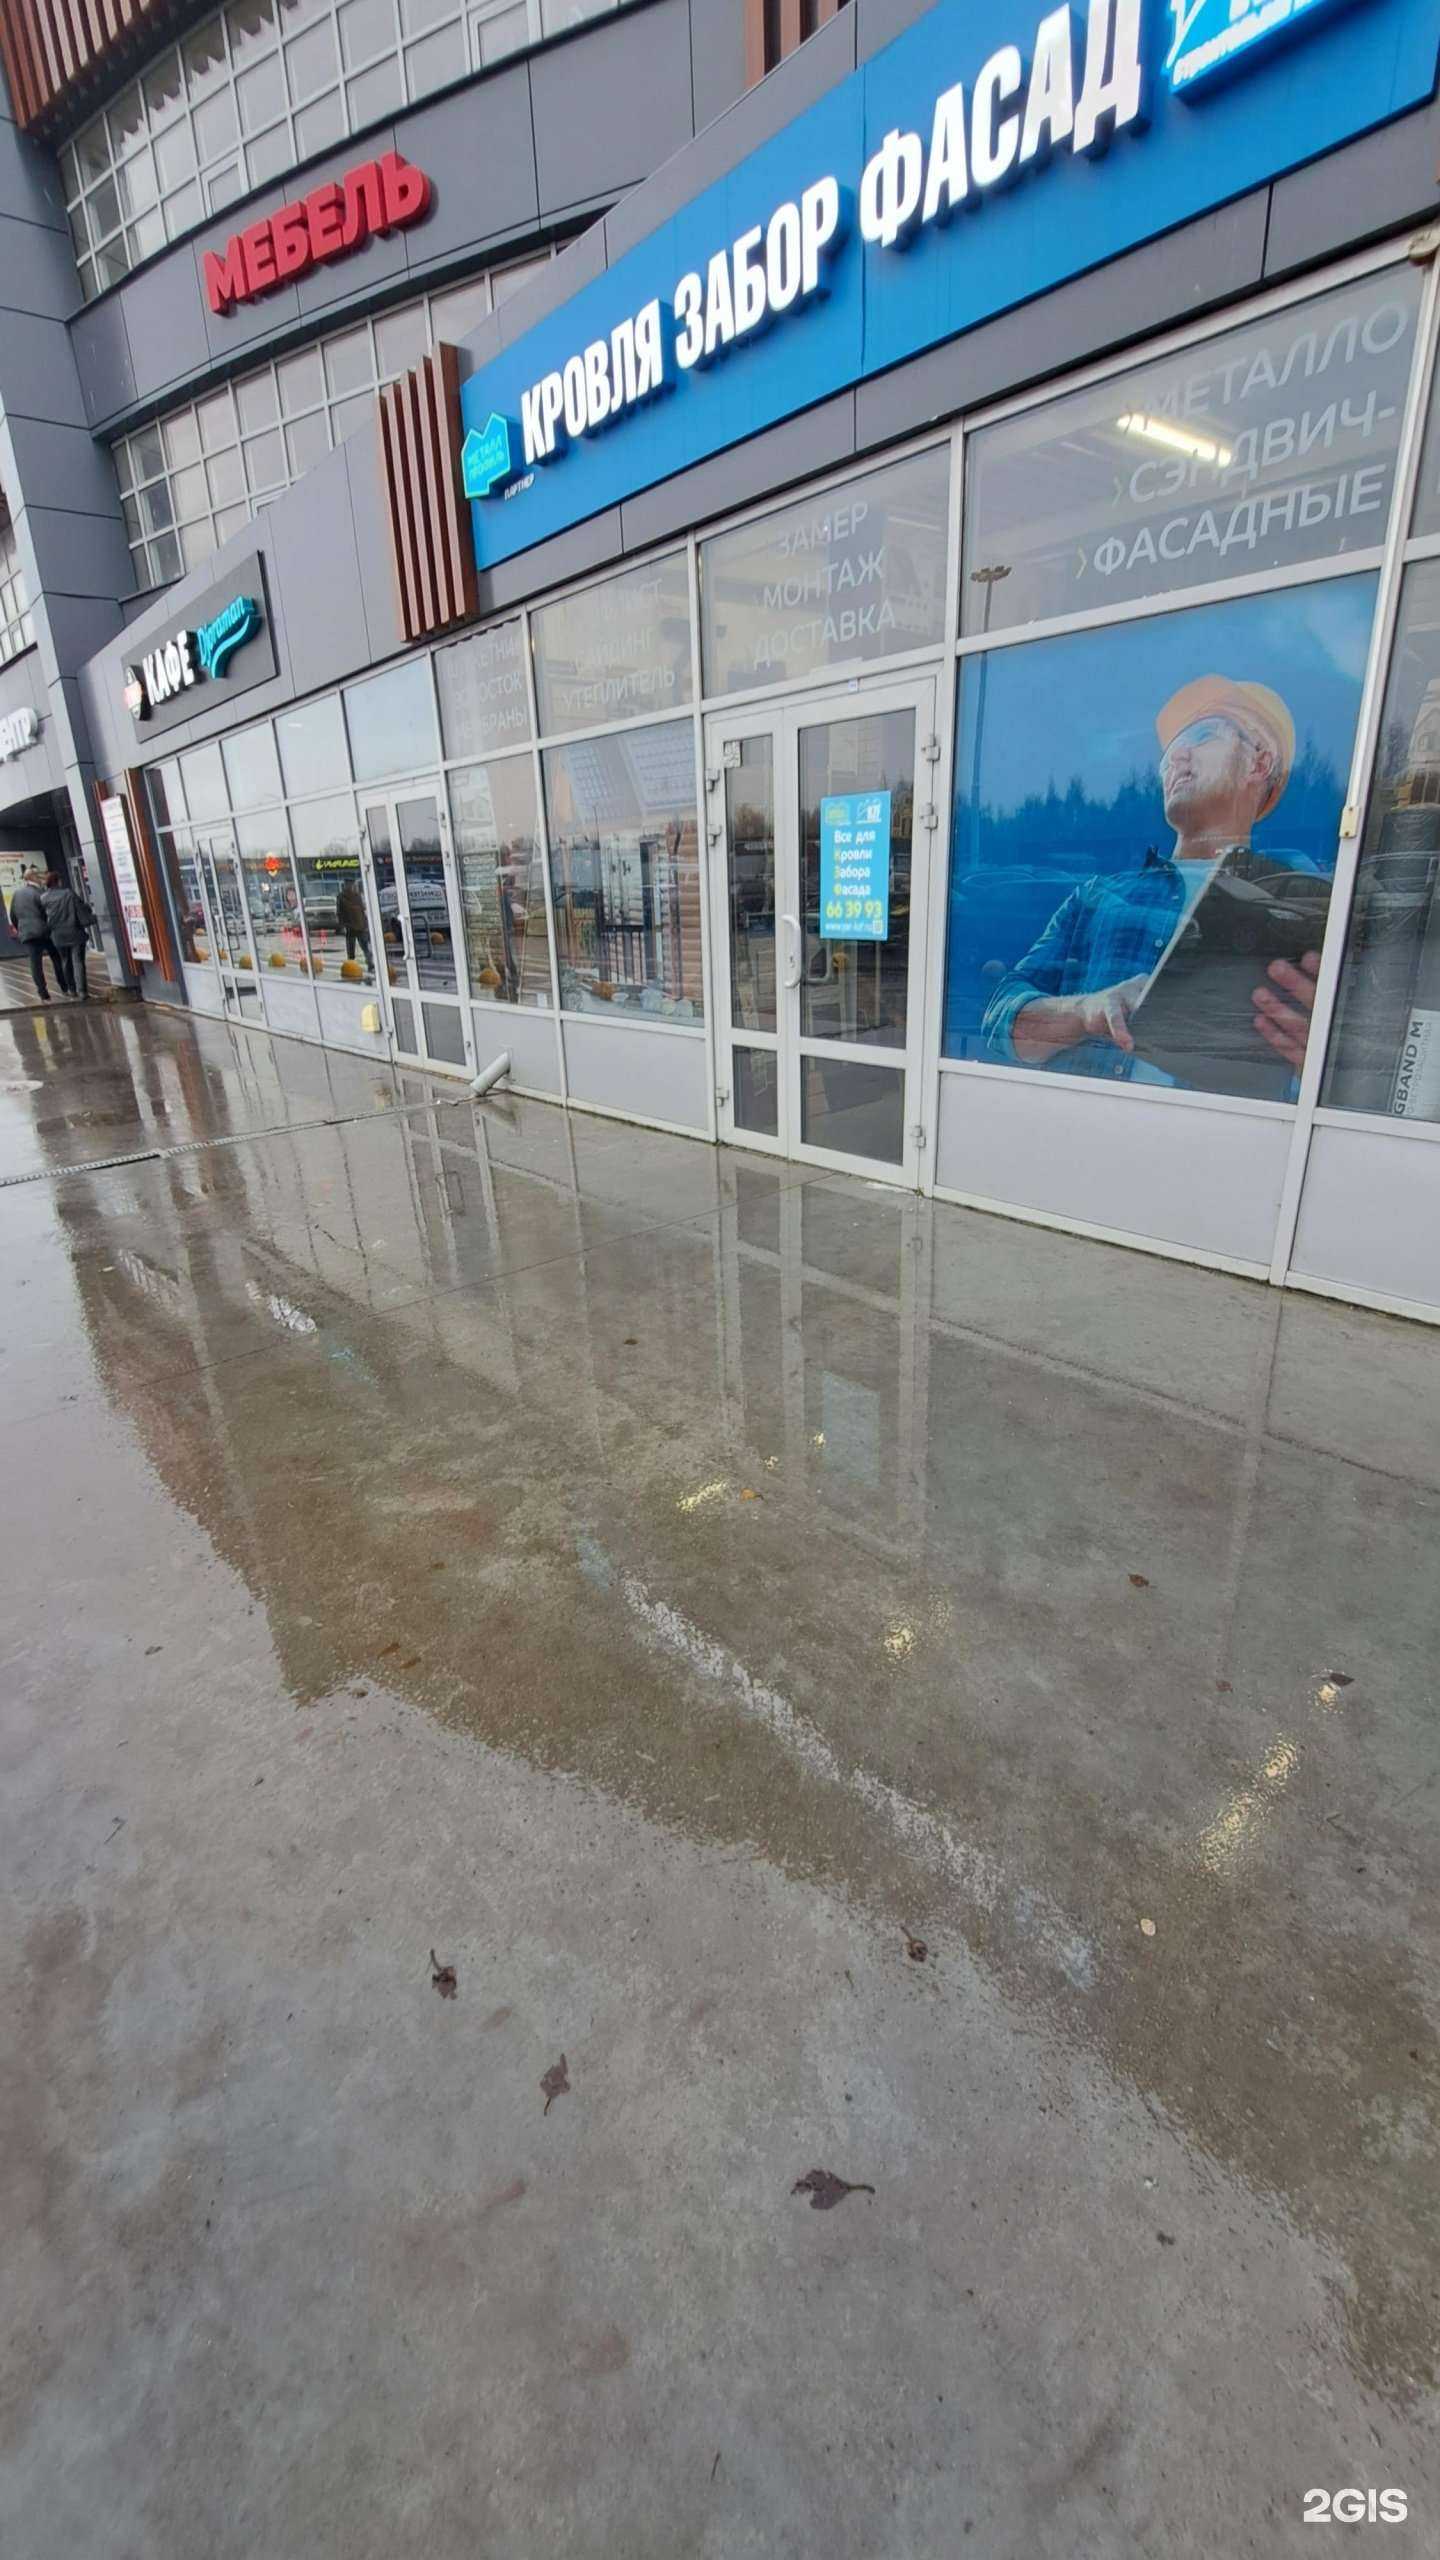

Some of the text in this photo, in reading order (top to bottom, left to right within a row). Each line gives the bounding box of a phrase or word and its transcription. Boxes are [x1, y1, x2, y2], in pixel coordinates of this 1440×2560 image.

[203, 151, 428, 314] МЕБЕЛЬ
[520, 298, 664, 466] КРОВЛЯ
[673, 174, 840, 370] ЗАБОР
[859, 0, 1142, 249] ФАСАД
[778, 501, 869, 560] ЗАМЕР
[1093, 463, 1387, 576] ФАСАДНЫЕ
[763, 544, 888, 611] МОНТАЖ
[142, 629, 196, 707] КАФЕ
[753, 599, 897, 672] ДОСТАВКА
[834, 829, 876, 845] Все для
[834, 848, 872, 865] Кровли
[833, 883, 871, 898] Фасада
[834, 865, 871, 883] Забора
[826, 901, 883, 919] 66 39 93
[1393, 1021, 1424, 1115] GBAND M
